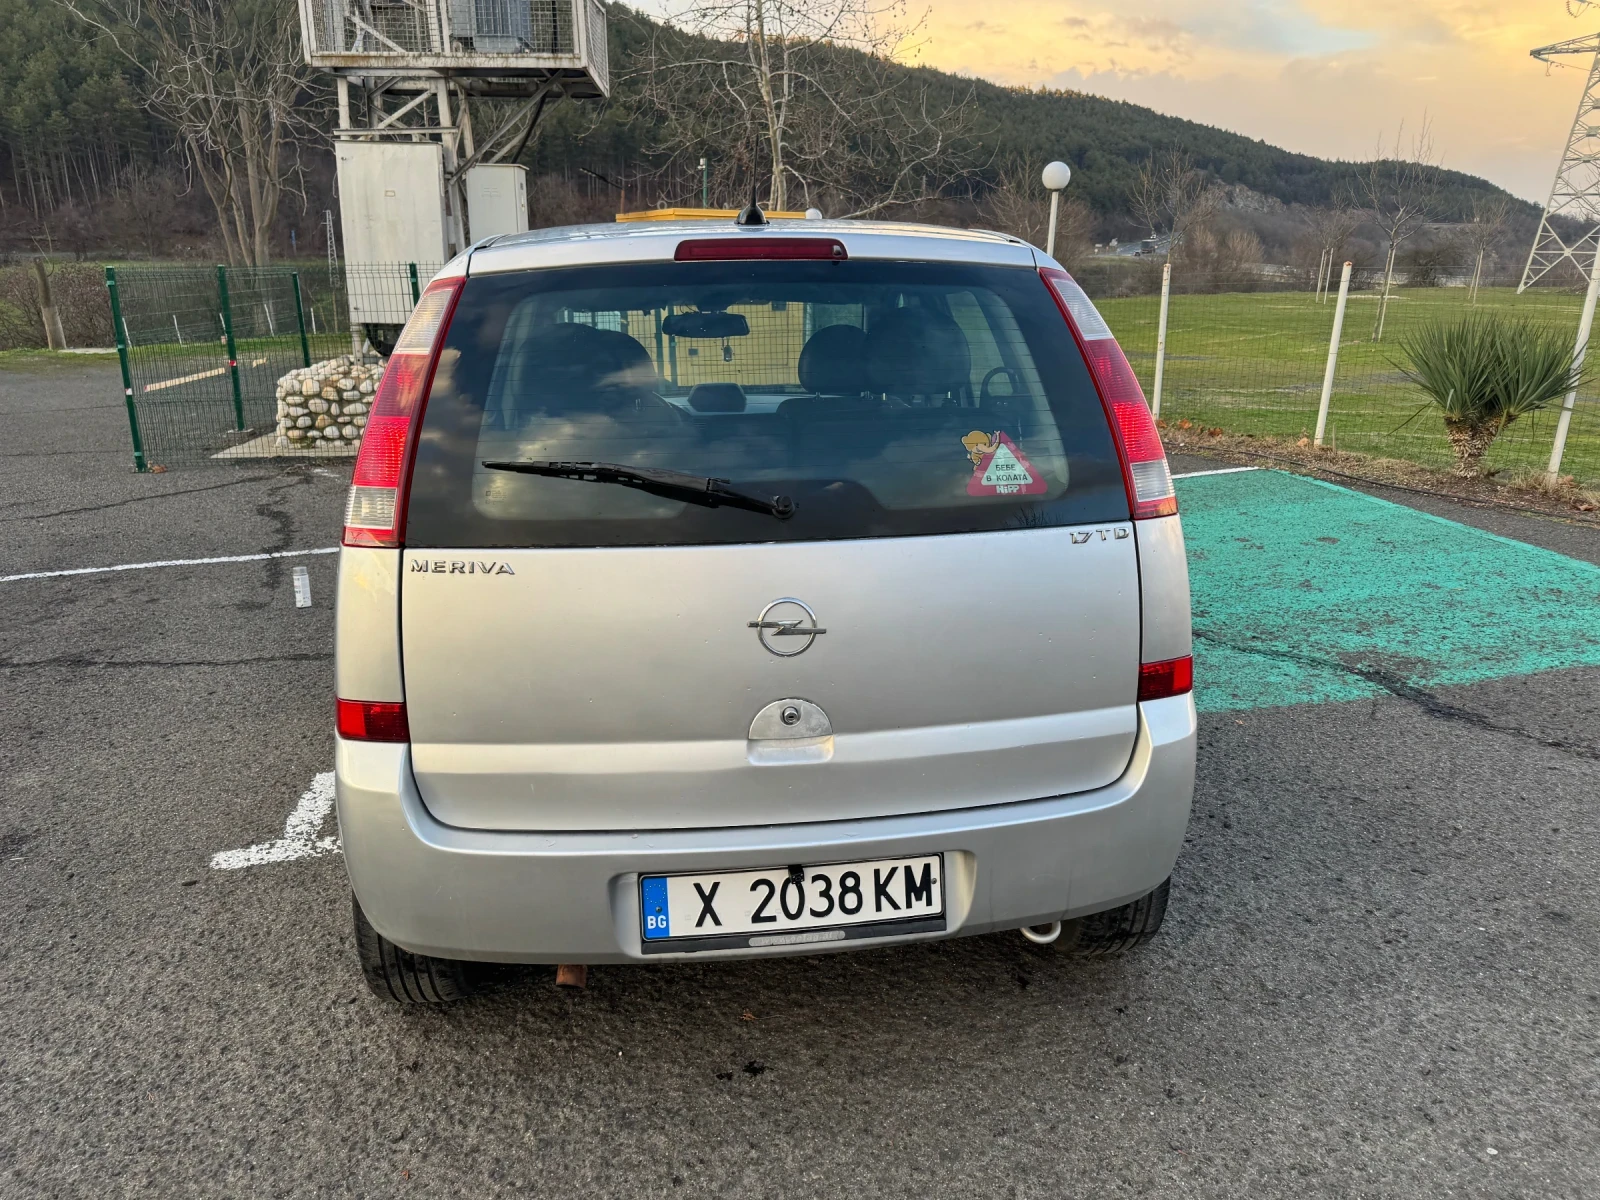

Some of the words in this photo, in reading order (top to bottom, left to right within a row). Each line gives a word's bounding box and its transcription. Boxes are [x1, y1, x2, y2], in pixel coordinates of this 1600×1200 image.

[410, 559, 515, 575] MERIVA
[749, 871, 863, 924] 2038
[873, 863, 933, 912] KM
[647, 916, 667, 929] BG
